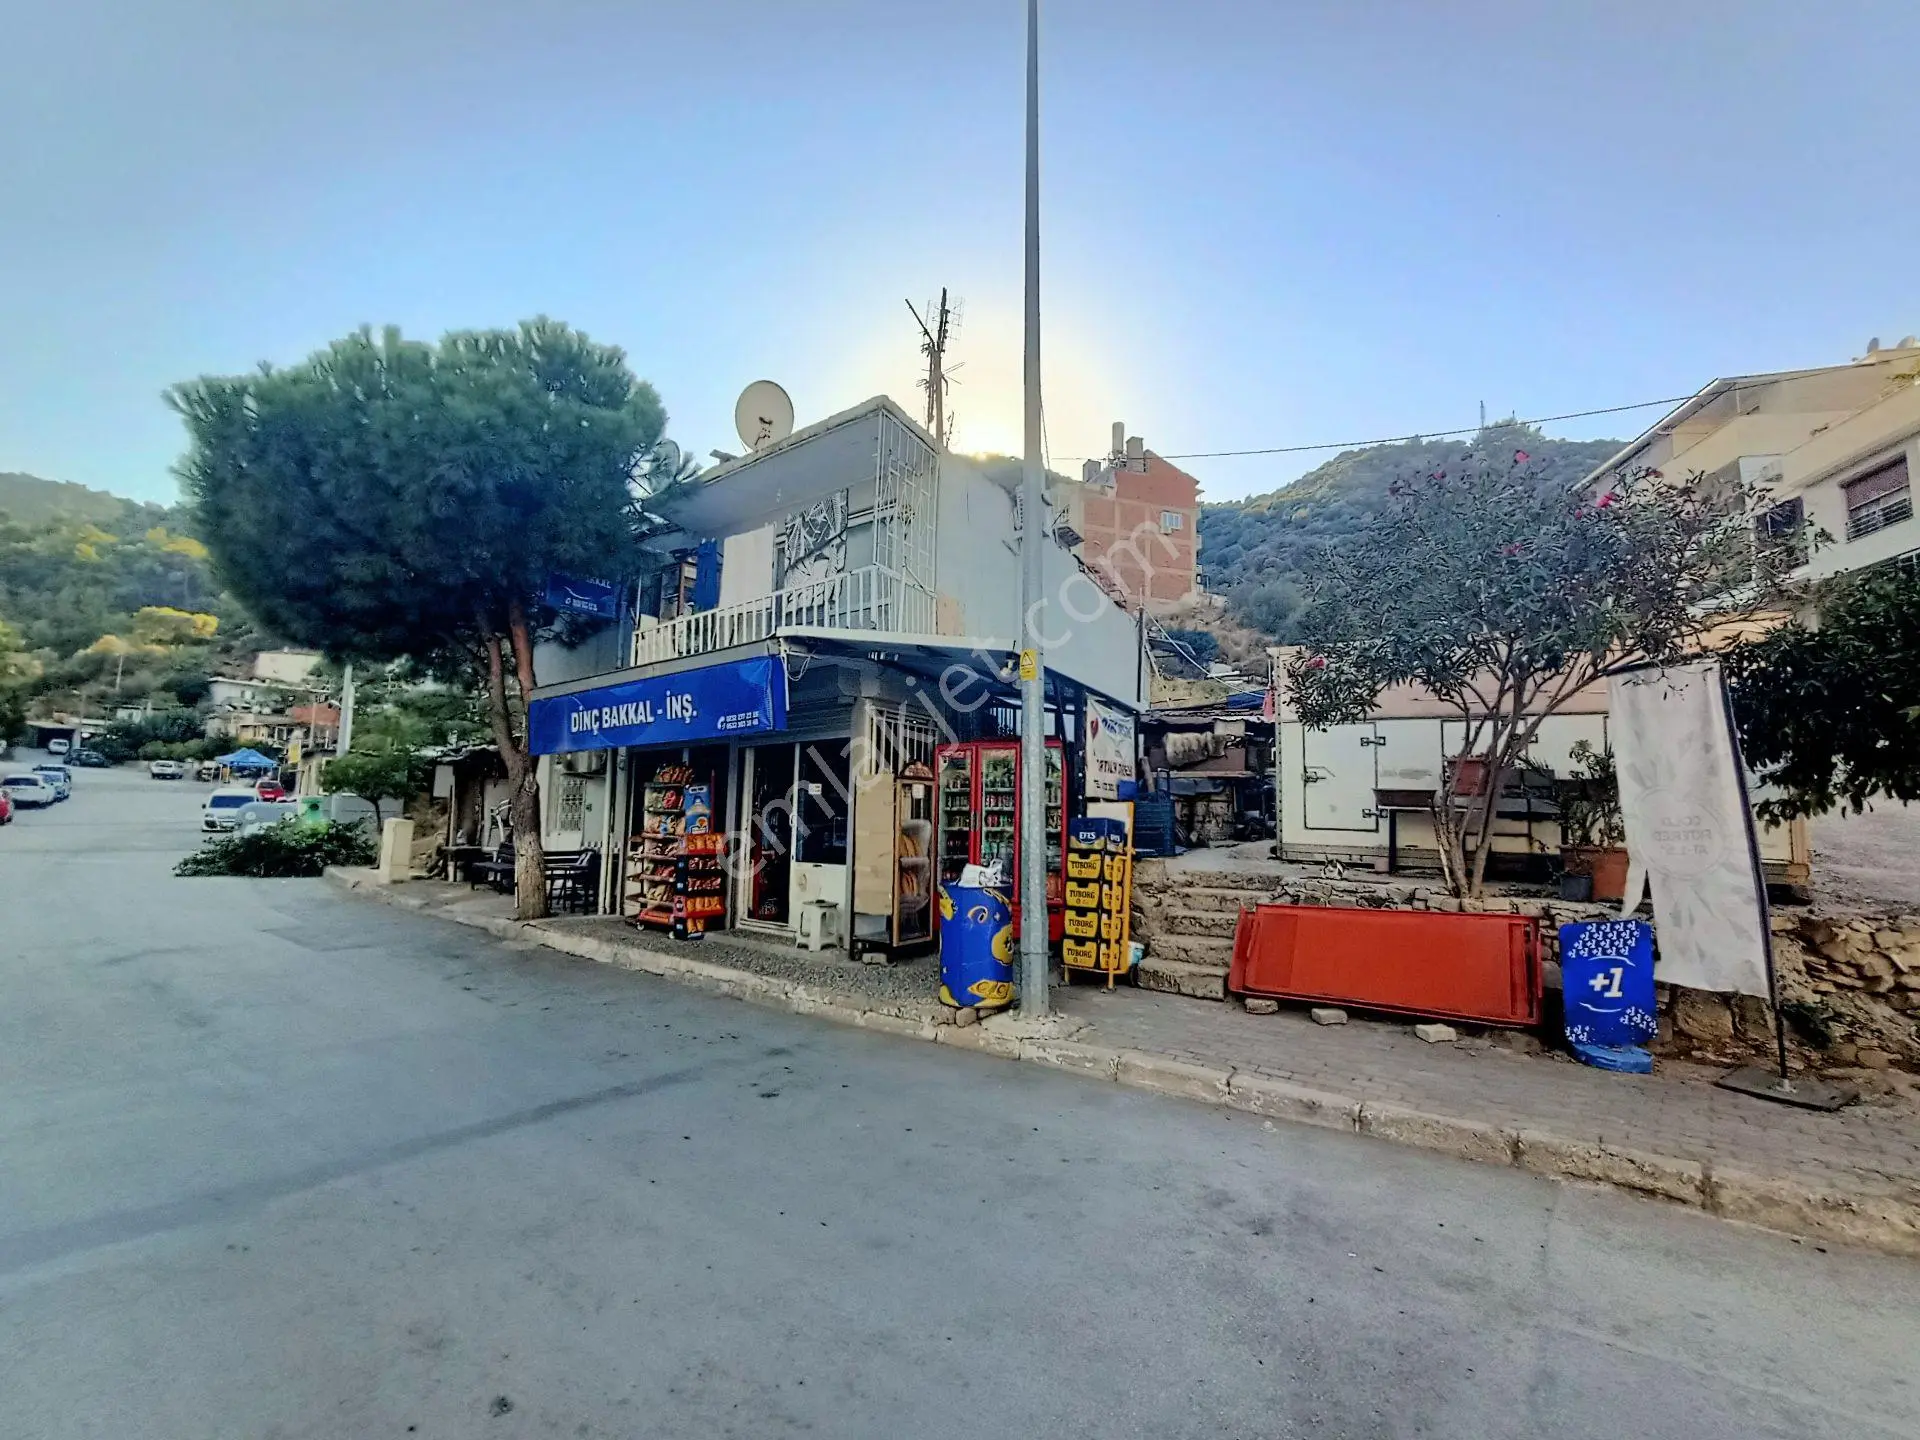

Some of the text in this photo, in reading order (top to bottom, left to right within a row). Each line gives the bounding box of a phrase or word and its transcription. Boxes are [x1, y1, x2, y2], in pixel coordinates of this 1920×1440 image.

[571, 705, 599, 735] DİNÇ
[602, 700, 655, 728] BAKKAL
[666, 690, 697, 723] İNŞ.
[1071, 860, 1096, 870] TUBORG
[1069, 890, 1095, 898] TUBORG
[1068, 919, 1094, 928] TUBORG
[1067, 948, 1092, 958] TUBORG
[1589, 968, 1623, 997] +1
